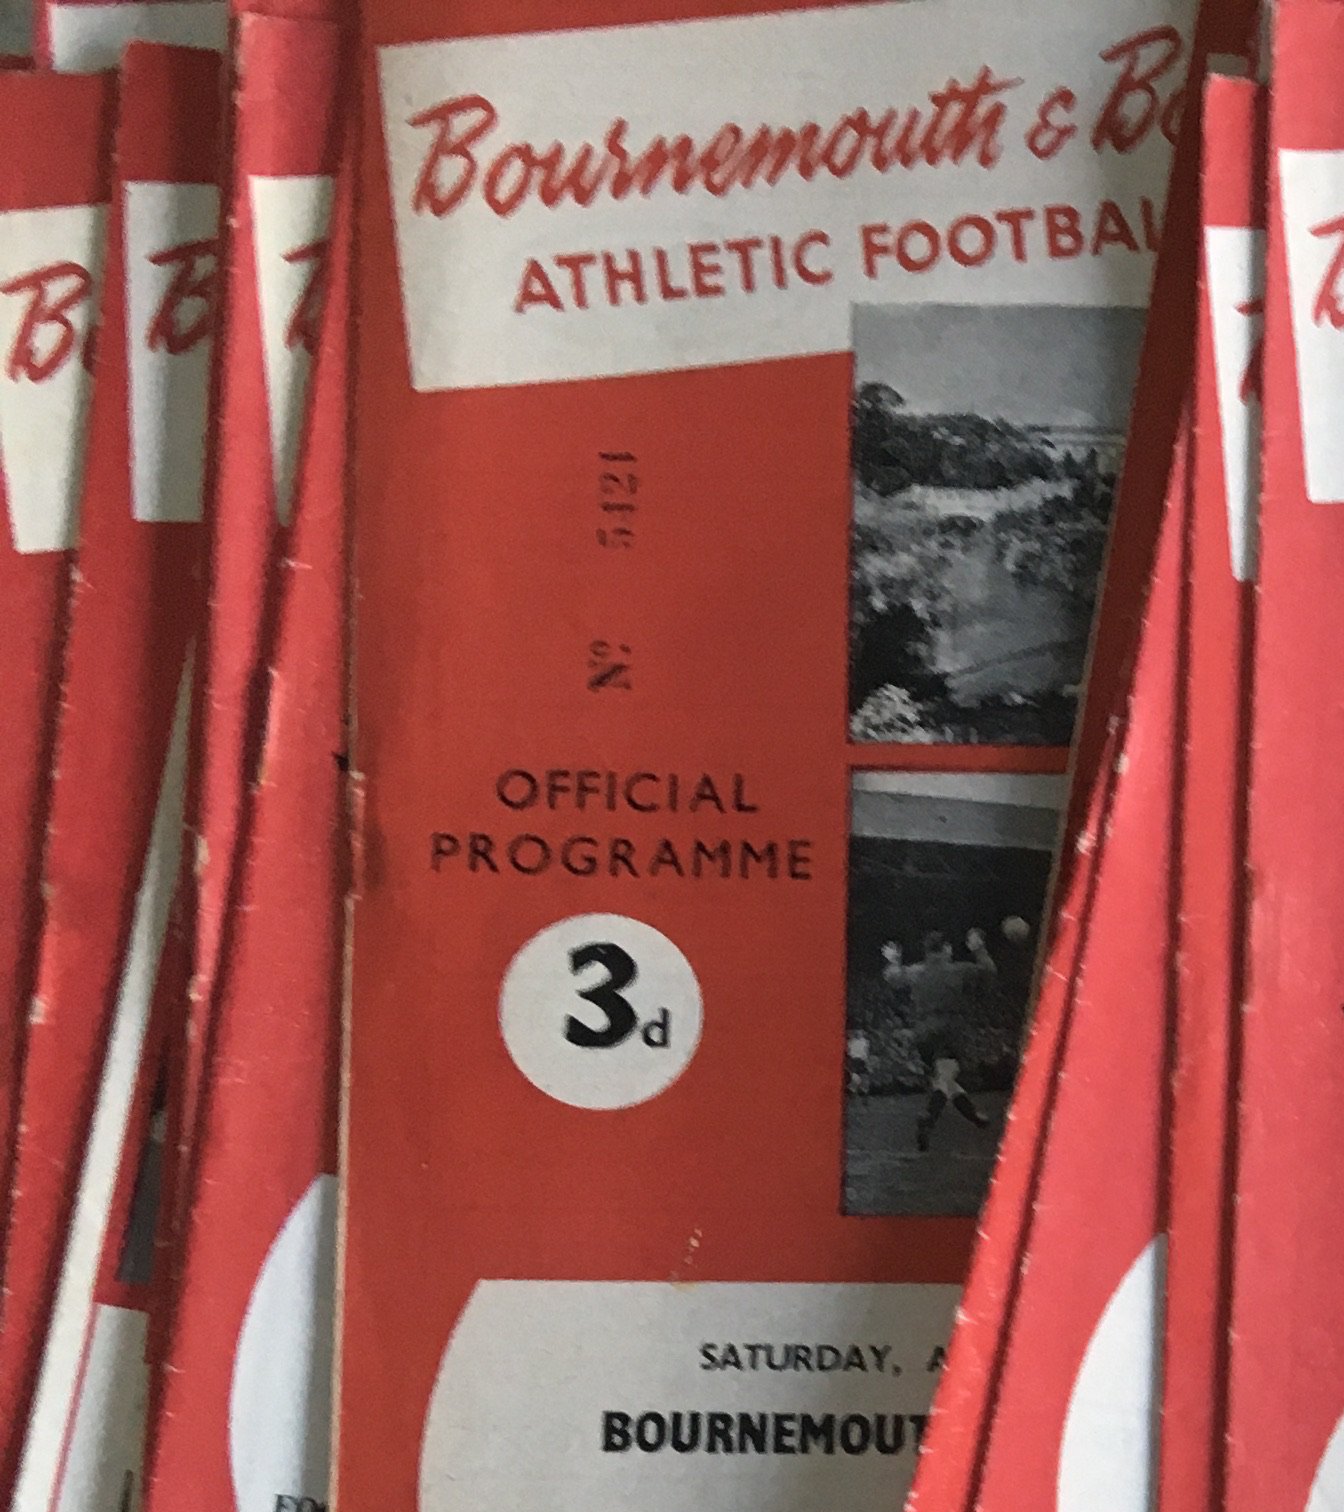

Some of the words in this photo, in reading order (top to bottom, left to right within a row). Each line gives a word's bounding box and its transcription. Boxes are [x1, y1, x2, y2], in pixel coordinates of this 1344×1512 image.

[408, 66, 1024, 219] Bournemouth
[1028, 86, 1076, 160] &
[514, 232, 834, 314] ATHLETIC
[496, 768, 761, 816] OFFICIAL
[429, 833, 815, 882] PROGRAMME
